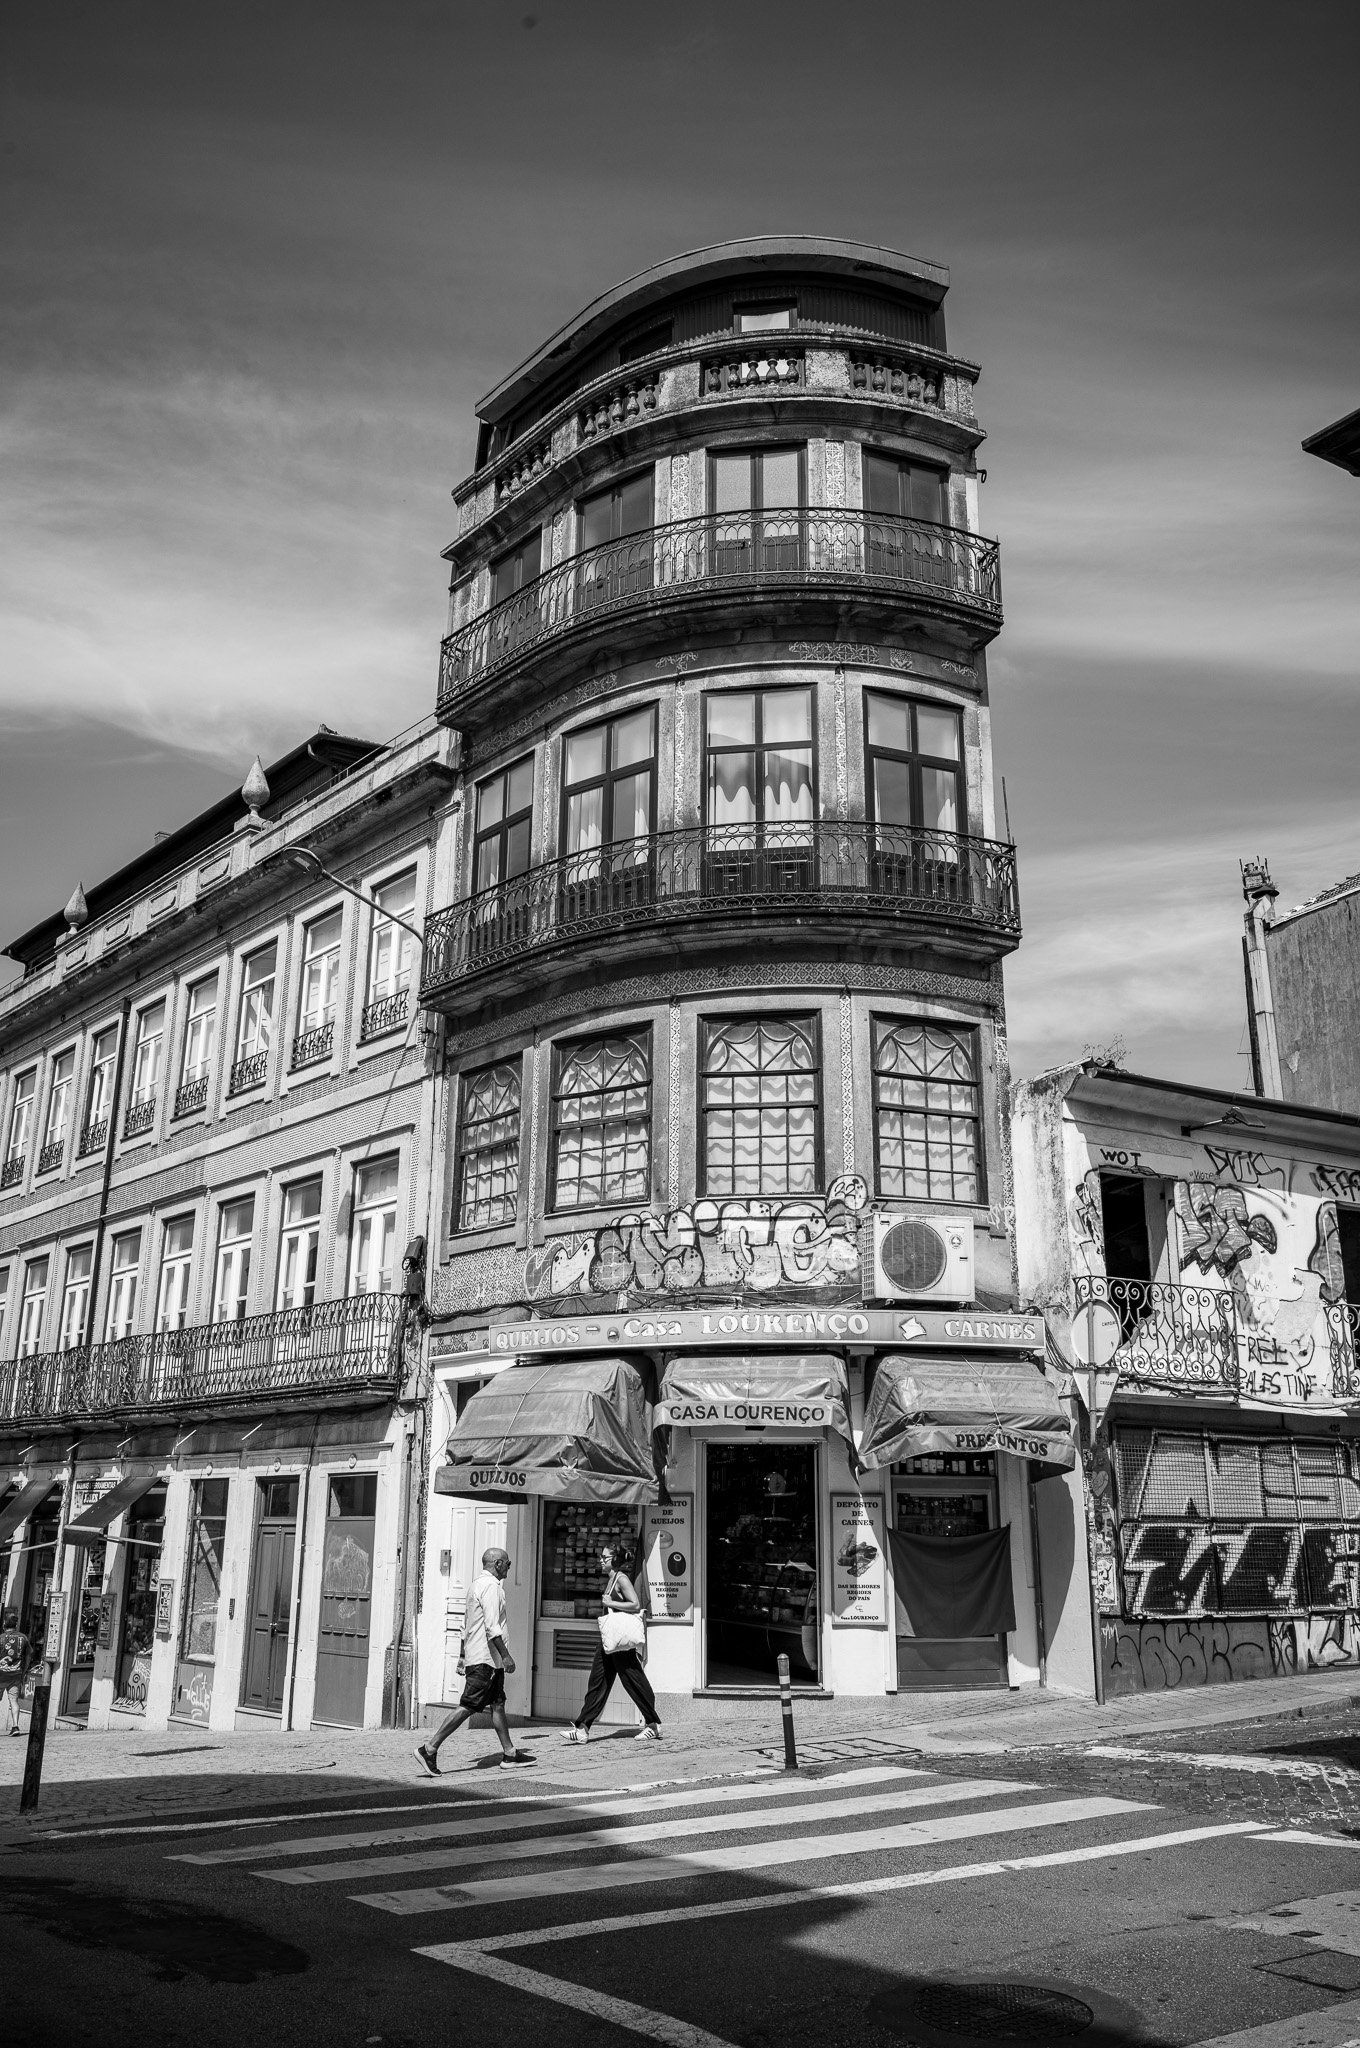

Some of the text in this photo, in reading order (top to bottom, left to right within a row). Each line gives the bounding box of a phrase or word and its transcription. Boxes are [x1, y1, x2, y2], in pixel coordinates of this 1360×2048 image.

[1100, 1149, 1141, 1167] WOT
[496, 1312, 1036, 1349] QUEIJOS Casa LOURENÇO CARNES
[670, 1405, 825, 1424] CASA LOURENÇO
[469, 1470, 527, 1487] QUEIJOS
